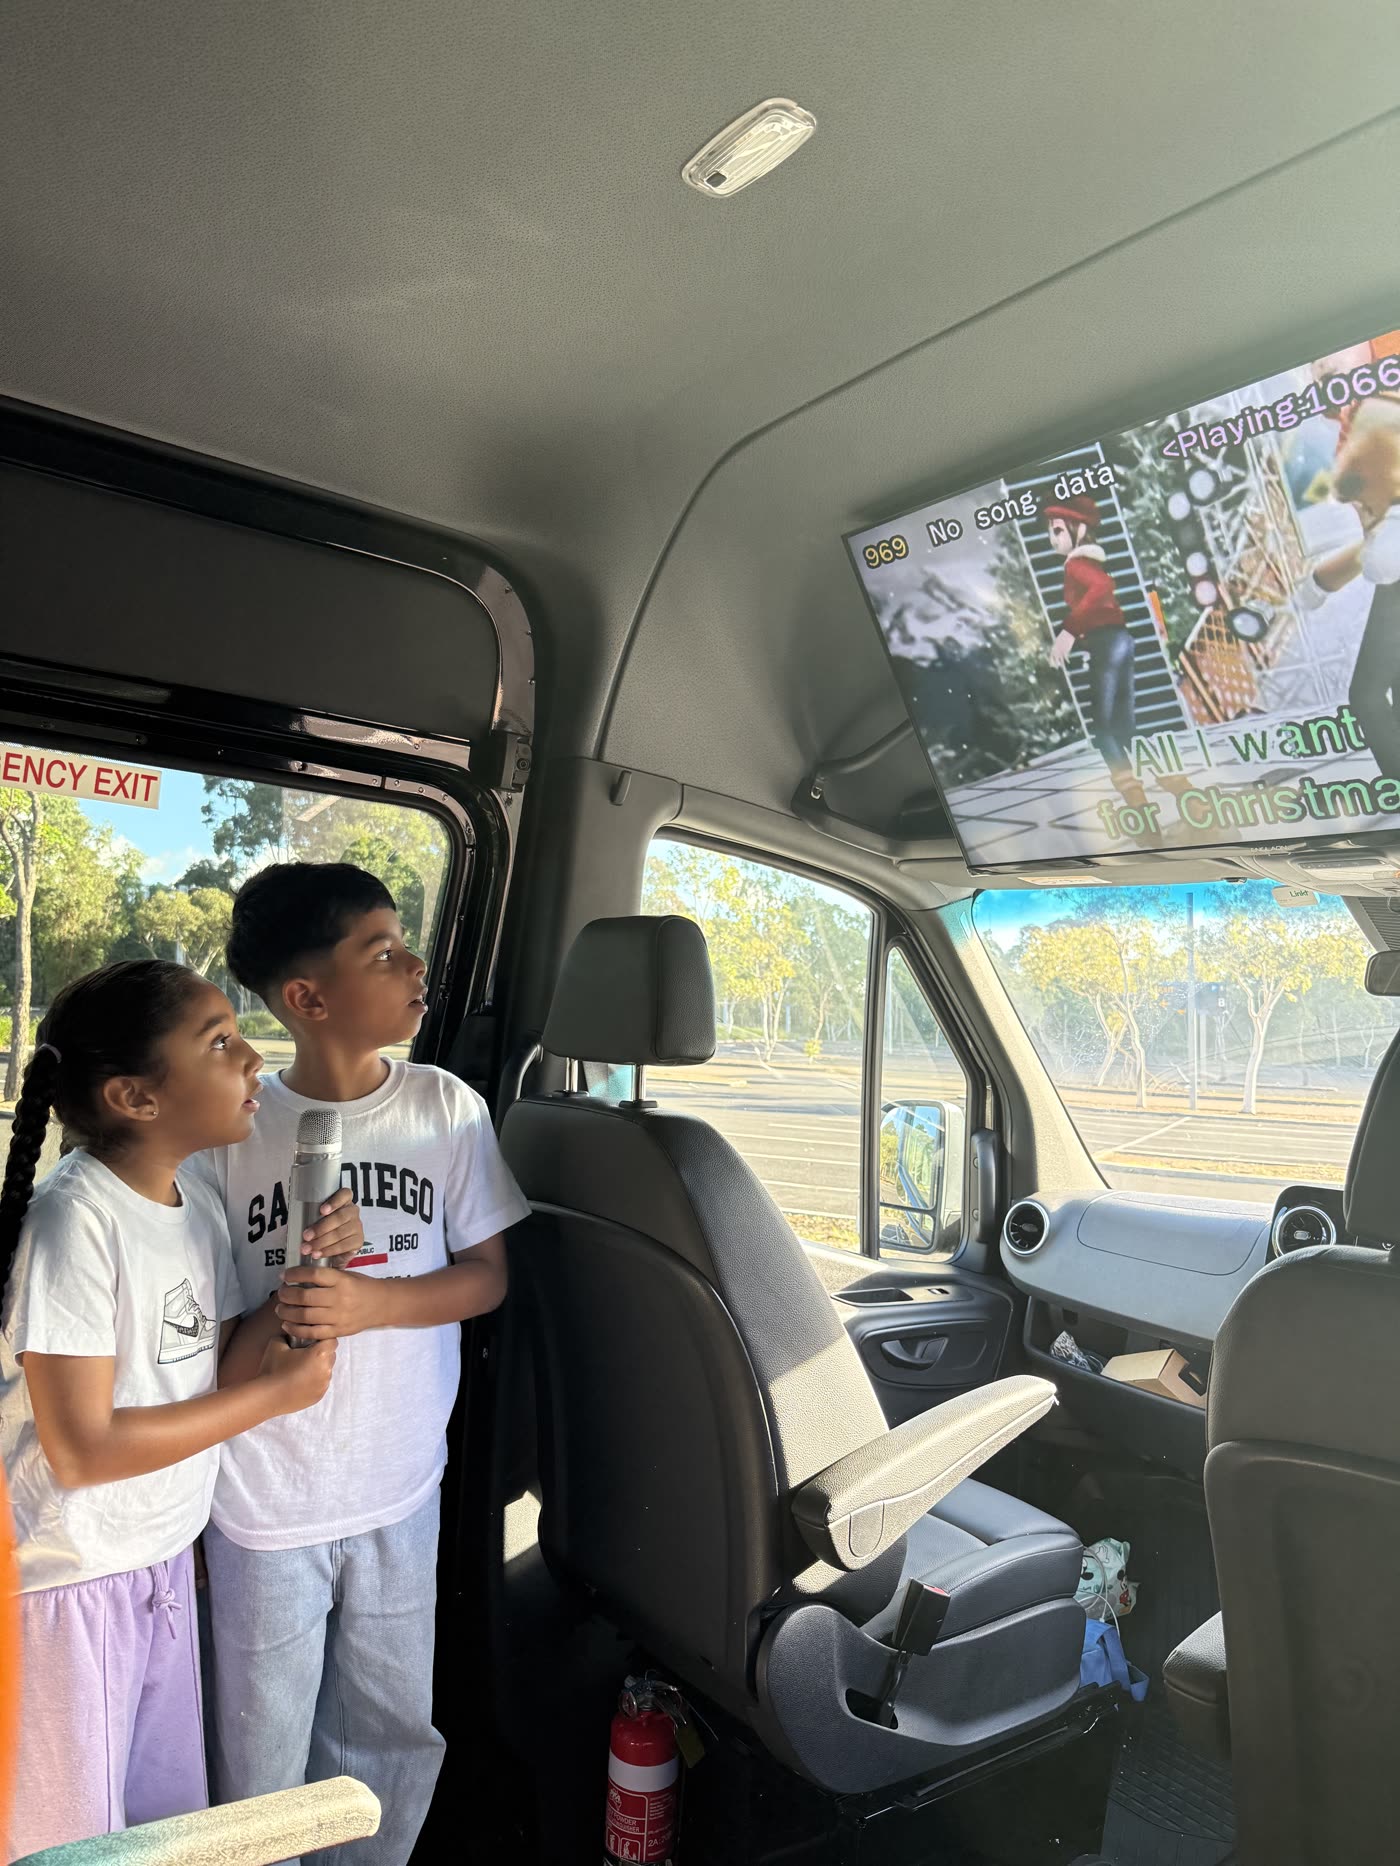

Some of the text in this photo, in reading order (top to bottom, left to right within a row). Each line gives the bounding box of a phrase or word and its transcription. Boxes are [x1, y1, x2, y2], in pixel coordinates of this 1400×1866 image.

[864, 465, 1115, 567] 969 No song data
[1134, 708, 1366, 778] All I want
[0, 752, 158, 802] ENCY EXIT
[1100, 802, 1160, 838] for
[247, 1176, 291, 1244] SA
[264, 1247, 287, 1267] ES
[388, 1232, 419, 1252] 1850
